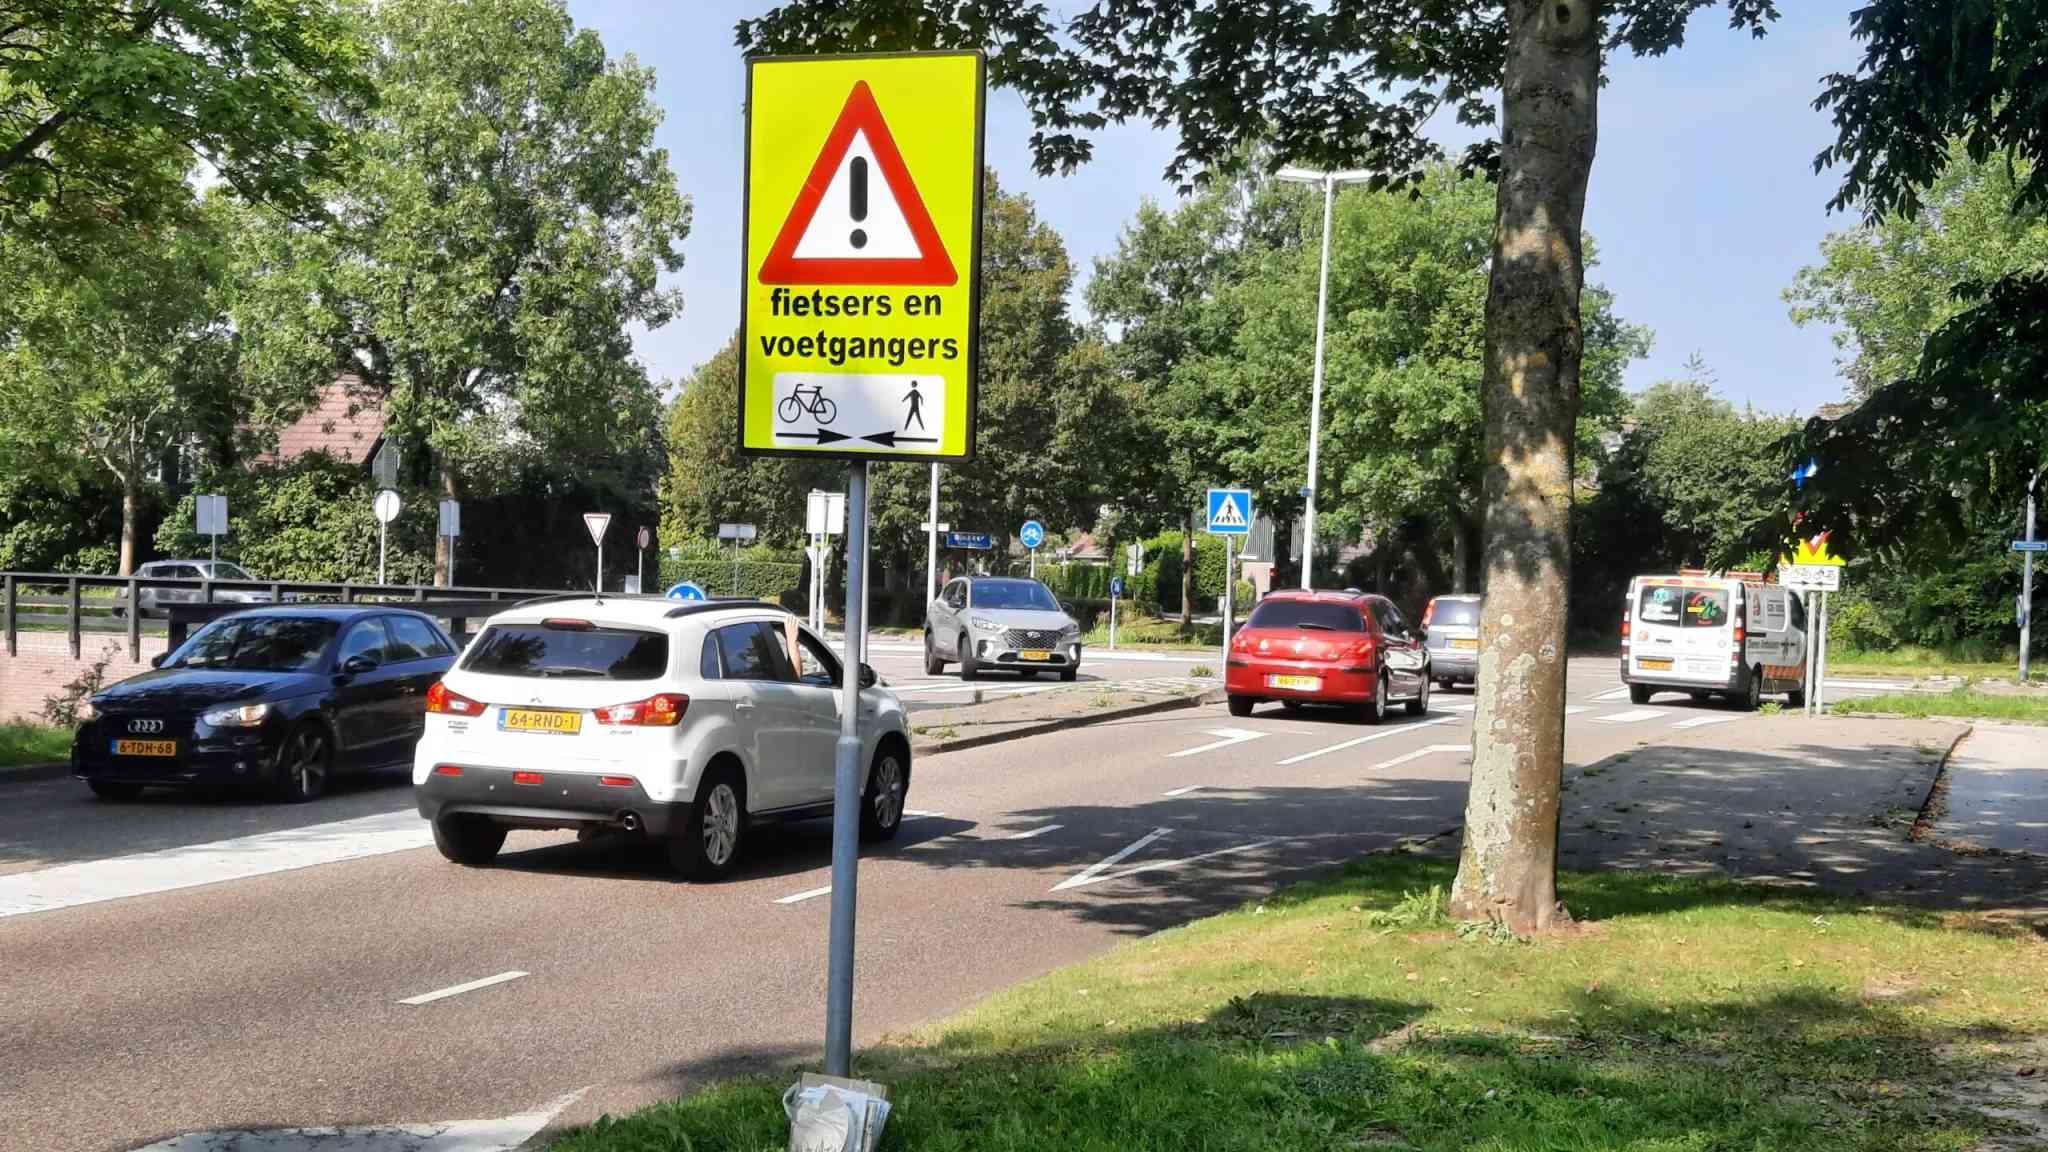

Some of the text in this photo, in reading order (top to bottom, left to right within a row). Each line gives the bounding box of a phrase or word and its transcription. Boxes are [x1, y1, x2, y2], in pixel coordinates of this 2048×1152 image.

[771, 288, 942, 316] fietsers en
[760, 330, 958, 366] voetgangers
[509, 711, 576, 729] 64-RND-1
